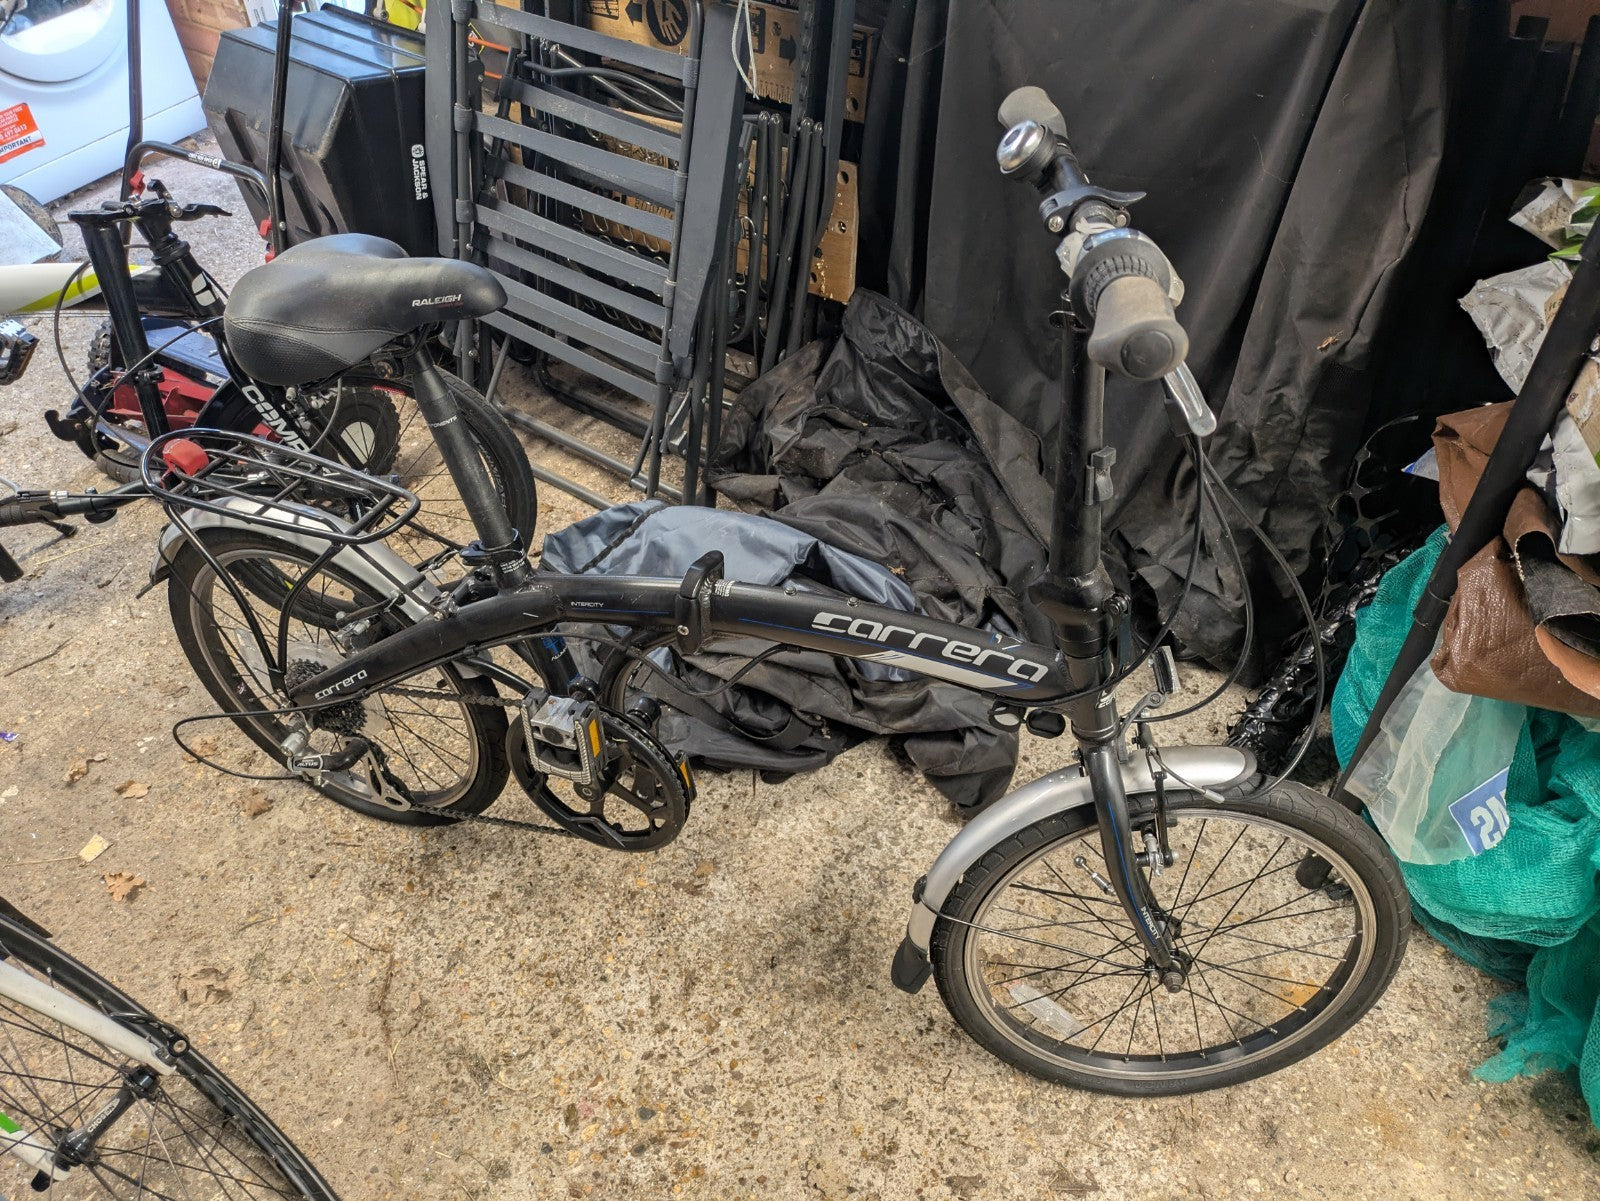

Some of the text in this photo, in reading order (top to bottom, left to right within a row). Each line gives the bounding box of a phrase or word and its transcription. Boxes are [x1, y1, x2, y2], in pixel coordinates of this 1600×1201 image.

[0, 136, 32, 154] MPORTANT
[412, 158, 423, 201] JACKSON
[419, 160, 428, 190] SPEAR
[412, 294, 462, 307] RALEIGH
[242, 385, 318, 460] COMP
[811, 611, 1050, 684] carrera
[314, 669, 368, 700] carrera
[1140, 906, 1161, 940] INTERCITY
